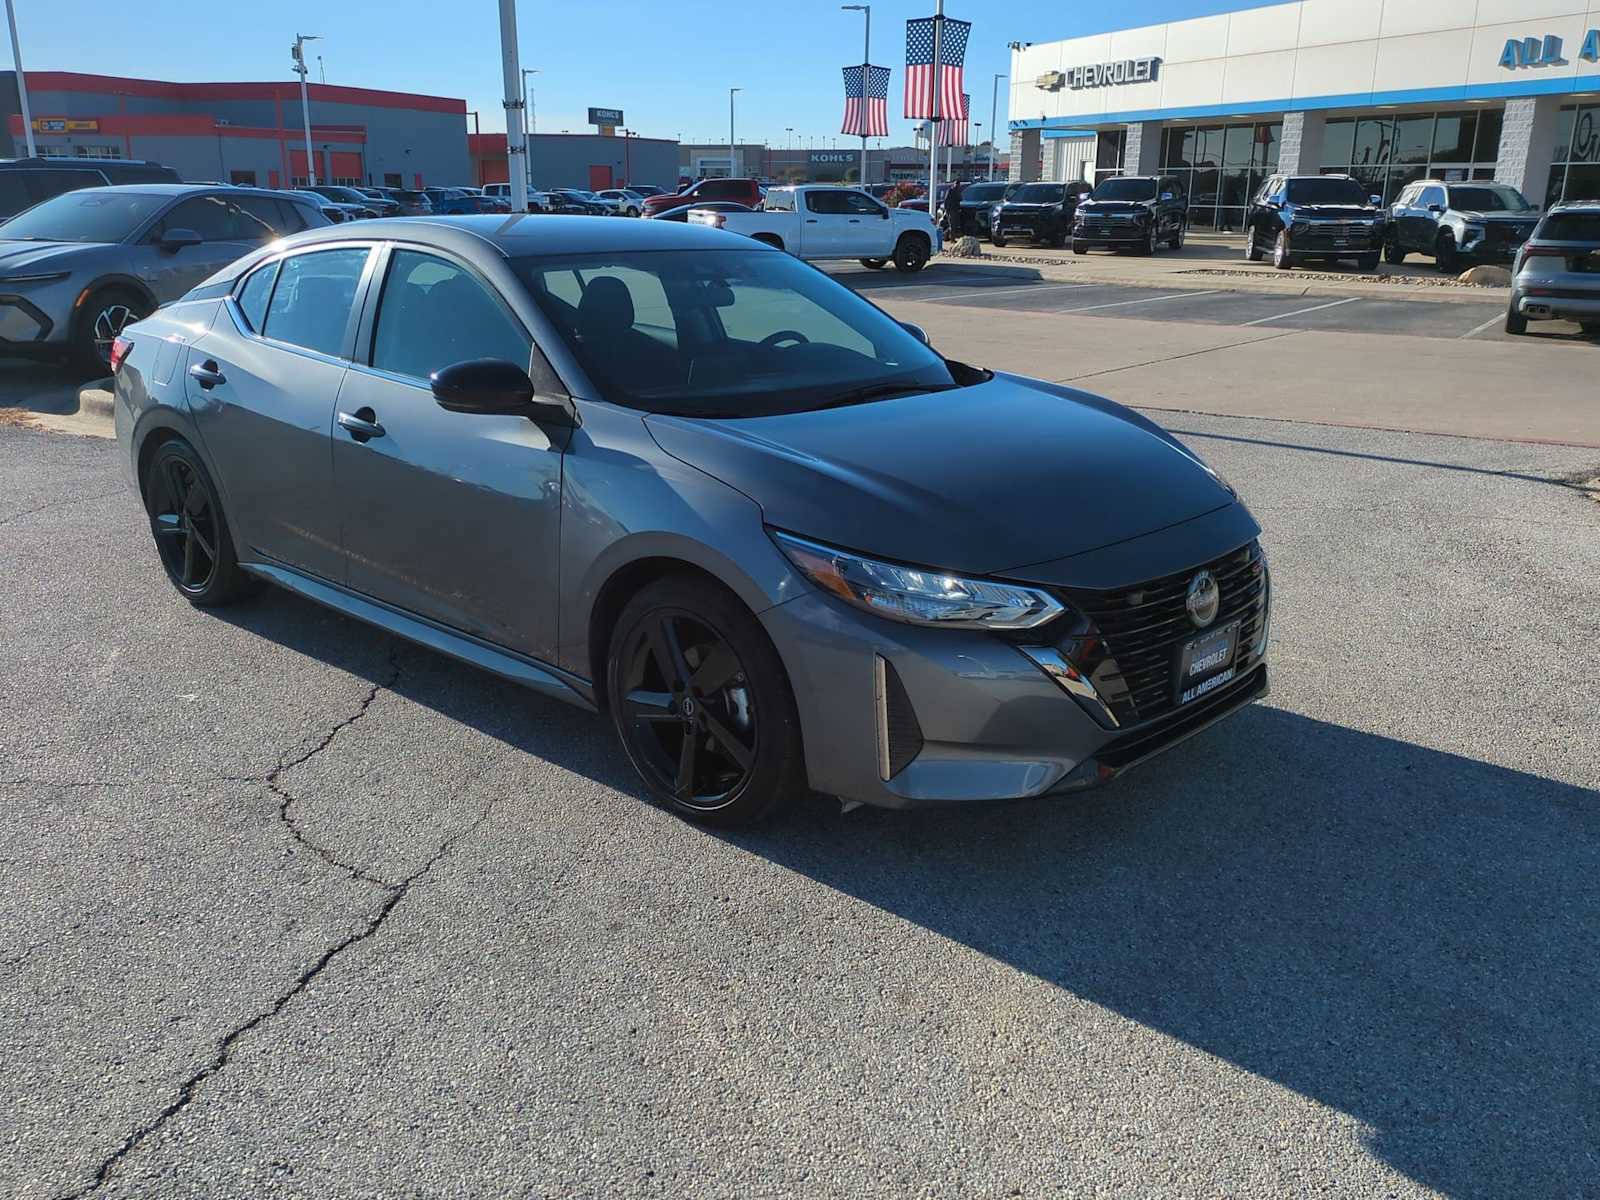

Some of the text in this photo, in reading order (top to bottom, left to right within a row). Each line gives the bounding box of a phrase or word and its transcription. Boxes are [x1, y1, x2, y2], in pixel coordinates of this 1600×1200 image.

[1497, 29, 1600, 71] ALL A
[1064, 56, 1162, 90] CHEVROLET
[1189, 648, 1228, 676] CHEVROLET
[1182, 668, 1233, 704] ALL AMERICAN
